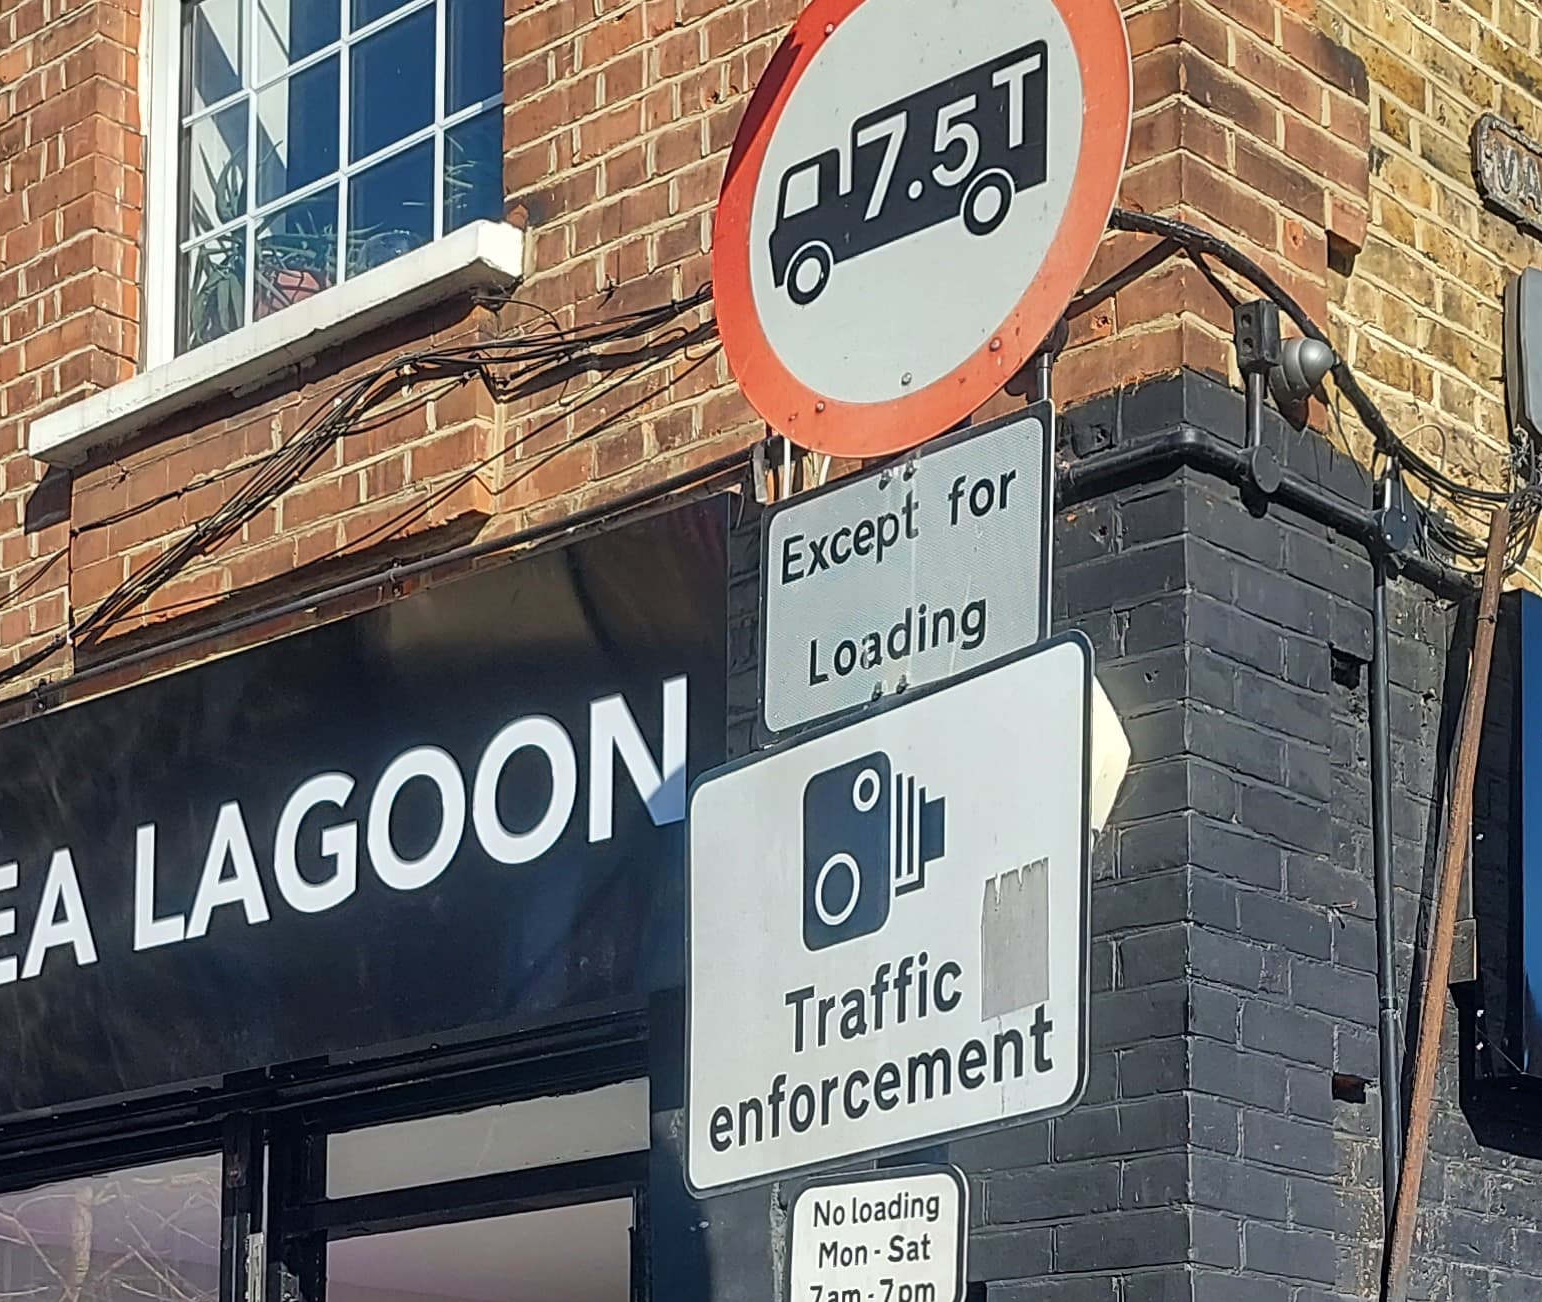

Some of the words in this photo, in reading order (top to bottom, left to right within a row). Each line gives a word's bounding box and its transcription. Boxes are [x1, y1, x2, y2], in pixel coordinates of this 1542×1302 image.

[858, 54, 1042, 221] 7.5T
[781, 490, 919, 584] Except
[948, 469, 1016, 526] for
[809, 599, 987, 686] Loading
[133, 673, 687, 951] LAGOON
[785, 951, 962, 1053] Traffic
[709, 1003, 1054, 1152] enforcement
[813, 1201, 846, 1228] No
[851, 1191, 940, 1225] loading
[818, 1240, 869, 1269] Mon
[887, 1233, 931, 1262] Sat
